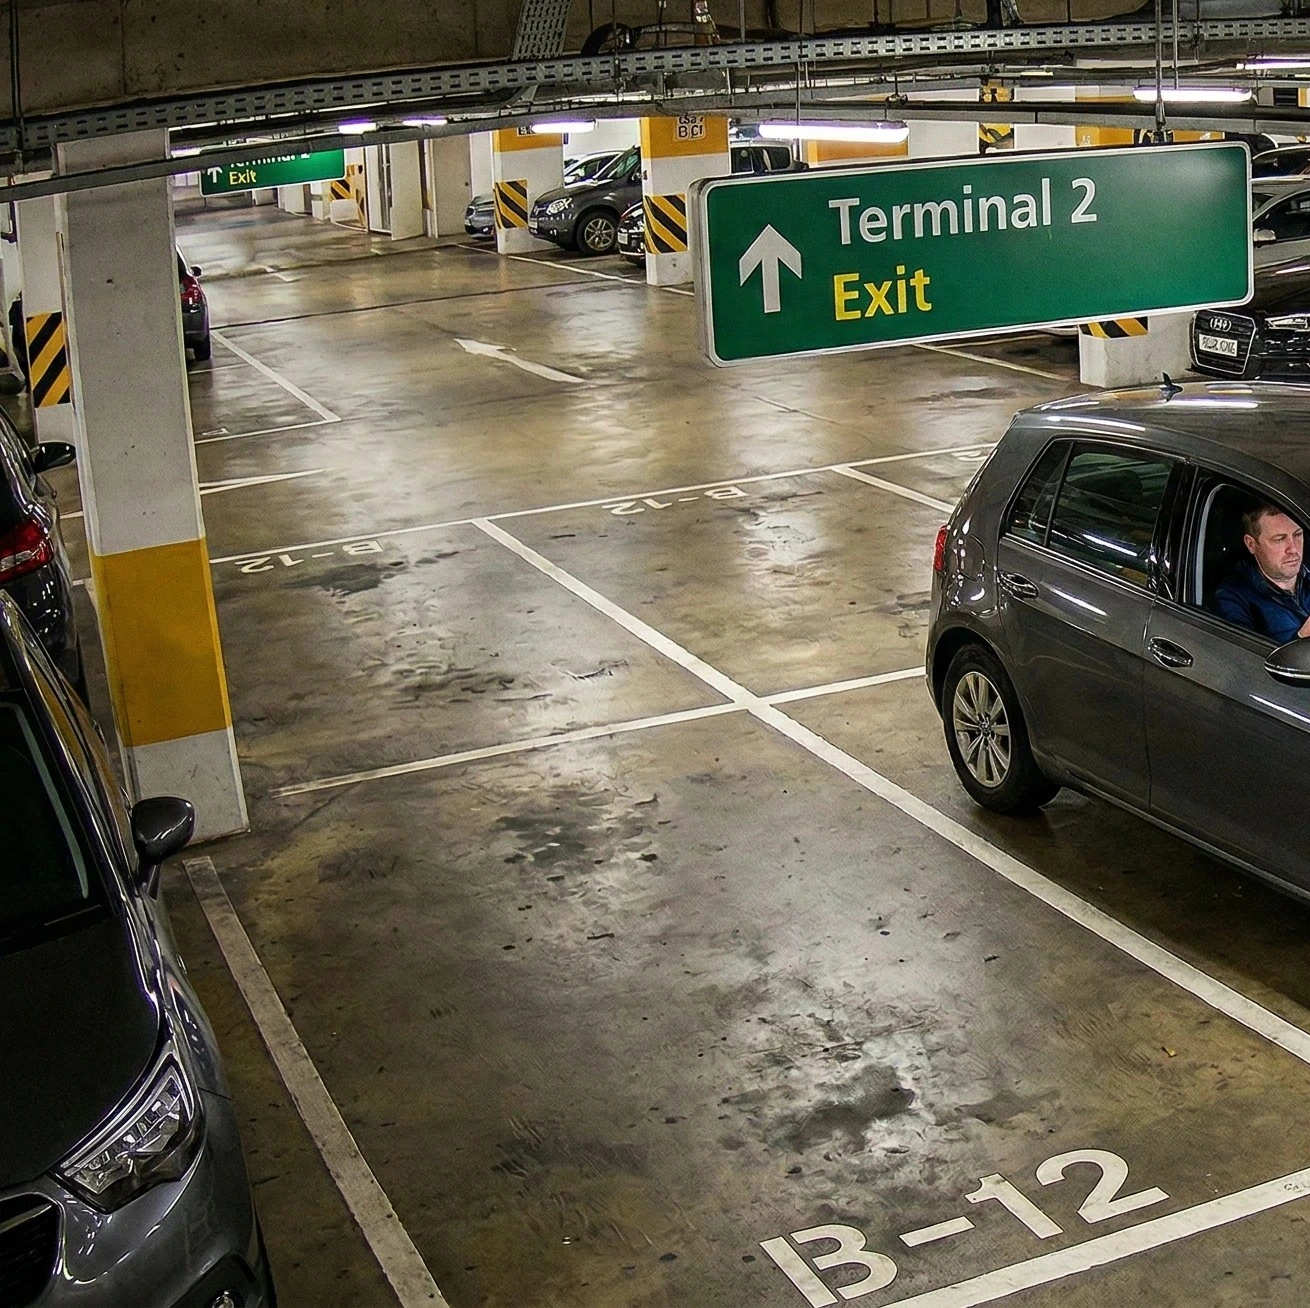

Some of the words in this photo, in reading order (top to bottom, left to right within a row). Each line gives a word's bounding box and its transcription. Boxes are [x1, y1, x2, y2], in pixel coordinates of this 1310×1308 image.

[228, 169, 257, 185] Exit
[829, 178, 1052, 245] Terminal
[1070, 178, 1098, 223] 2
[833, 265, 932, 321] Exit
[758, 1148, 1171, 1308] B-12
